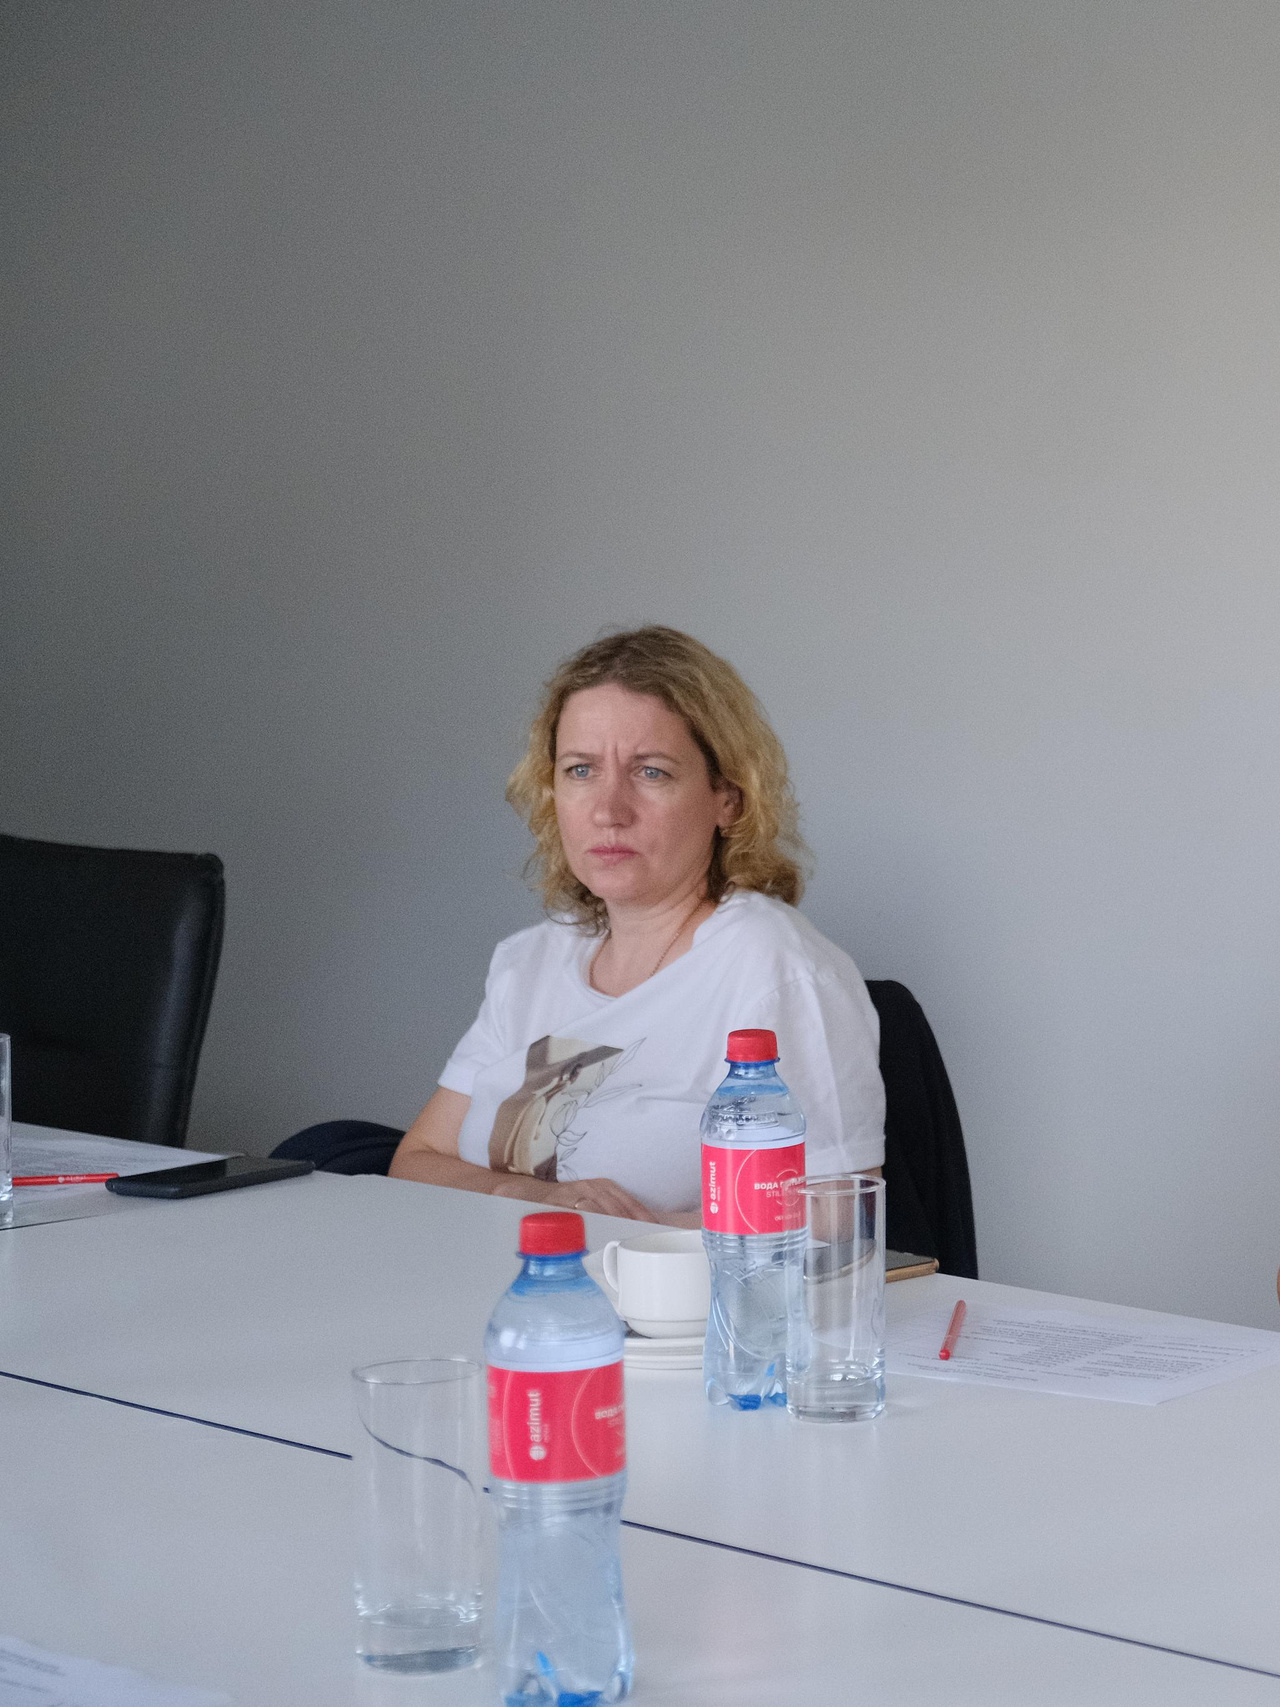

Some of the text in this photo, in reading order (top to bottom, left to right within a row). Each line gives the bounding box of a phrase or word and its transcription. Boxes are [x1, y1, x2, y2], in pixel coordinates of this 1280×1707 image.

[709, 1161, 717, 1200] azimut
[754, 1181, 778, 1191] ВОДА
[526, 1390, 541, 1443] azimut
